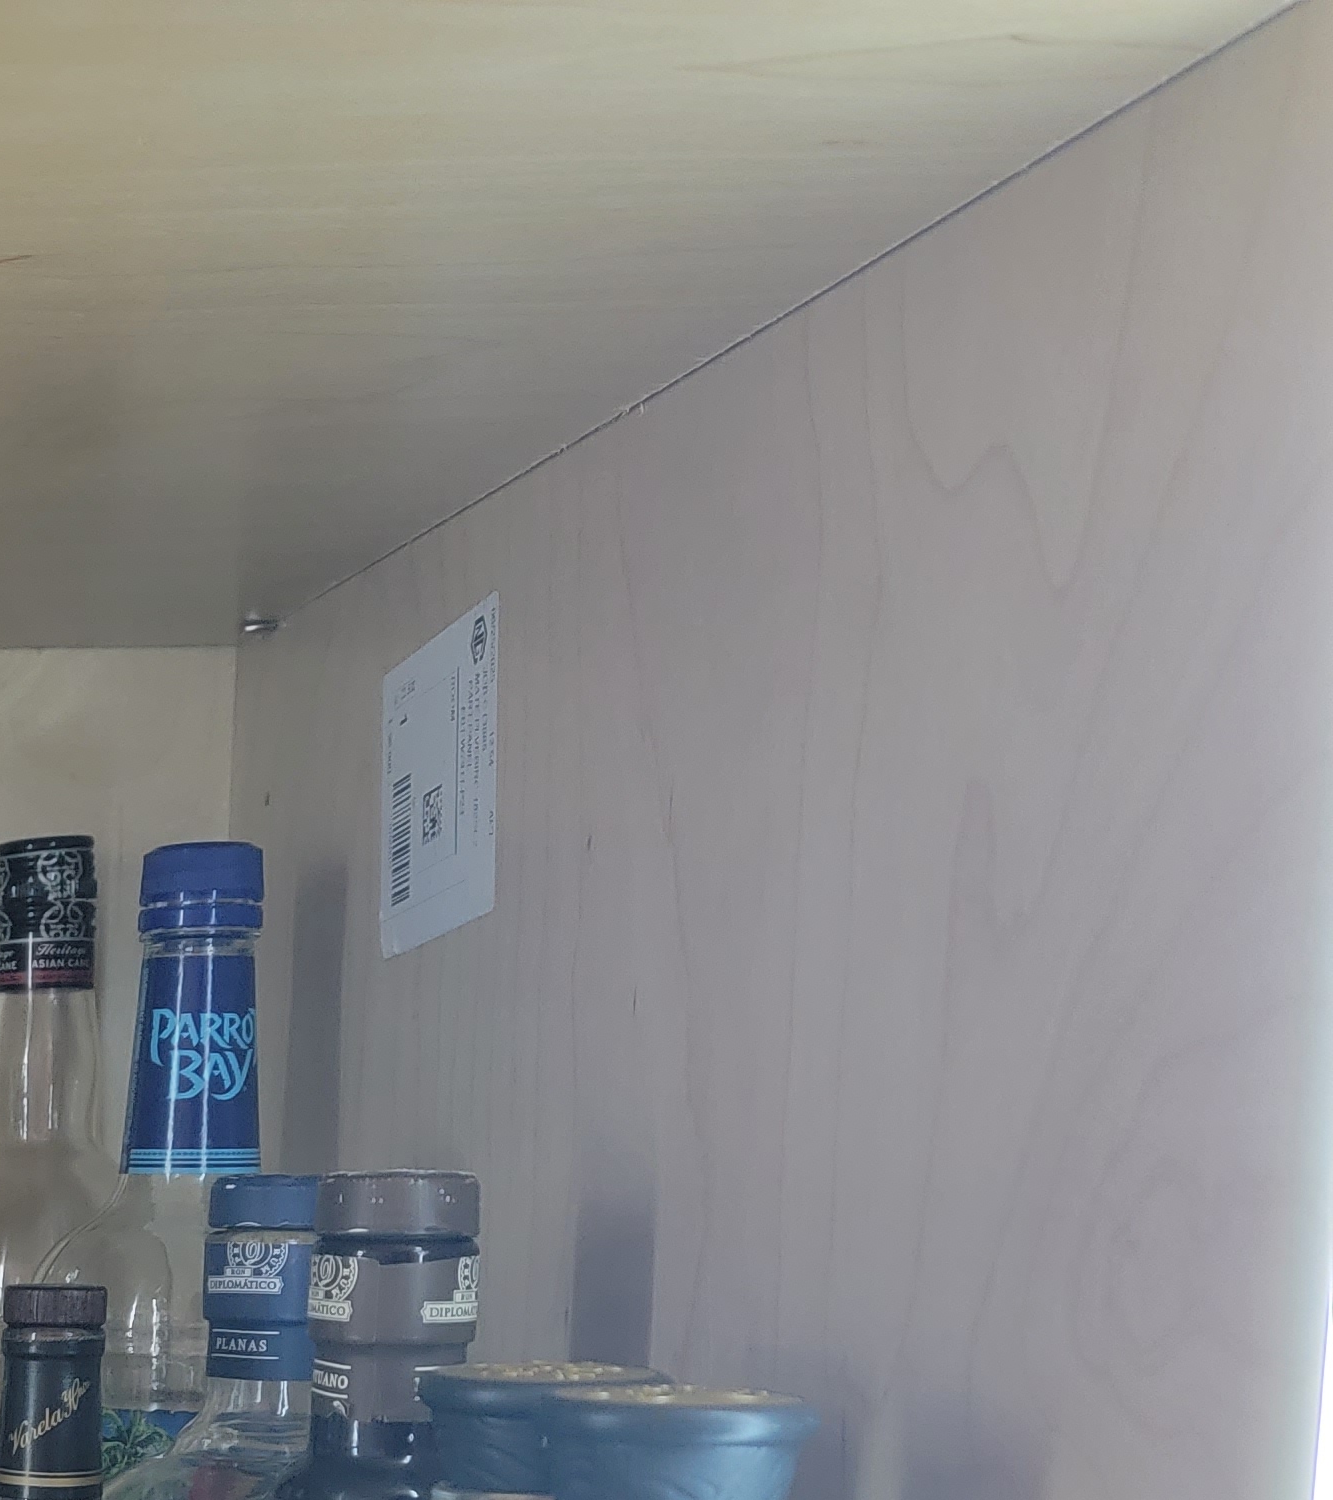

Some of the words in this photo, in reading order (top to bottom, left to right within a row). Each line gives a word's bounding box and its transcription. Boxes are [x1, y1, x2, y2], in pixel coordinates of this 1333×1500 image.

[32, 959, 64, 968] ASIAN
[151, 1007, 255, 1067] PARRO
[166, 1047, 253, 1101] BAY
[209, 1278, 278, 1292] DIPLOMÁTICO
[216, 1337, 268, 1353] PLANAS
